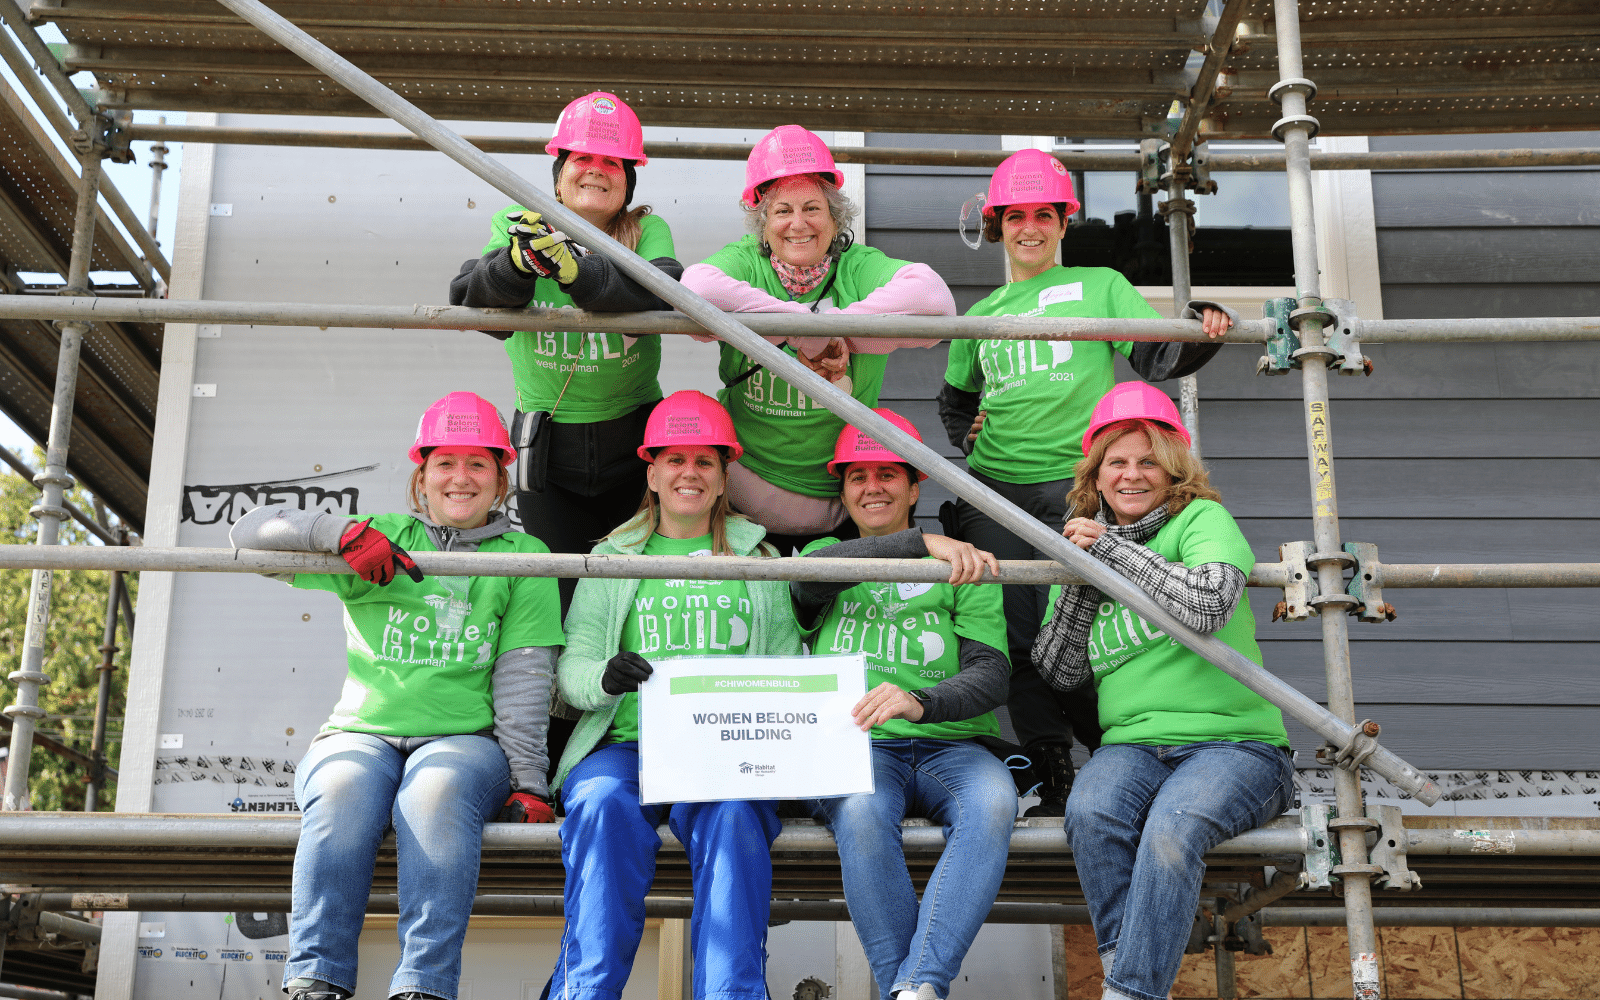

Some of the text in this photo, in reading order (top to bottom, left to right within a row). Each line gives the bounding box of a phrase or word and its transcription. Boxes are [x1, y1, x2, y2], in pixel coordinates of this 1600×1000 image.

[535, 359, 599, 373] west pullman
[621, 353, 641, 368] 2021
[1049, 372, 1074, 381] 2021
[743, 399, 763, 412] west
[445, 426, 481, 434] Building
[447, 419, 479, 427] Belong
[1310, 402, 1328, 479] SAFWAY
[180, 484, 359, 524] MENA
[634, 594, 750, 614] women
[842, 600, 940, 630] woen
[388, 605, 496, 643] women
[638, 610, 749, 654] BUILD
[830, 616, 945, 667] BUILD
[919, 669, 946, 679] 2021
[714, 679, 800, 689] #CHIWOMENBUILD
[692, 712, 818, 724] WOMEN BELONG
[720, 729, 792, 741] BUILDING
